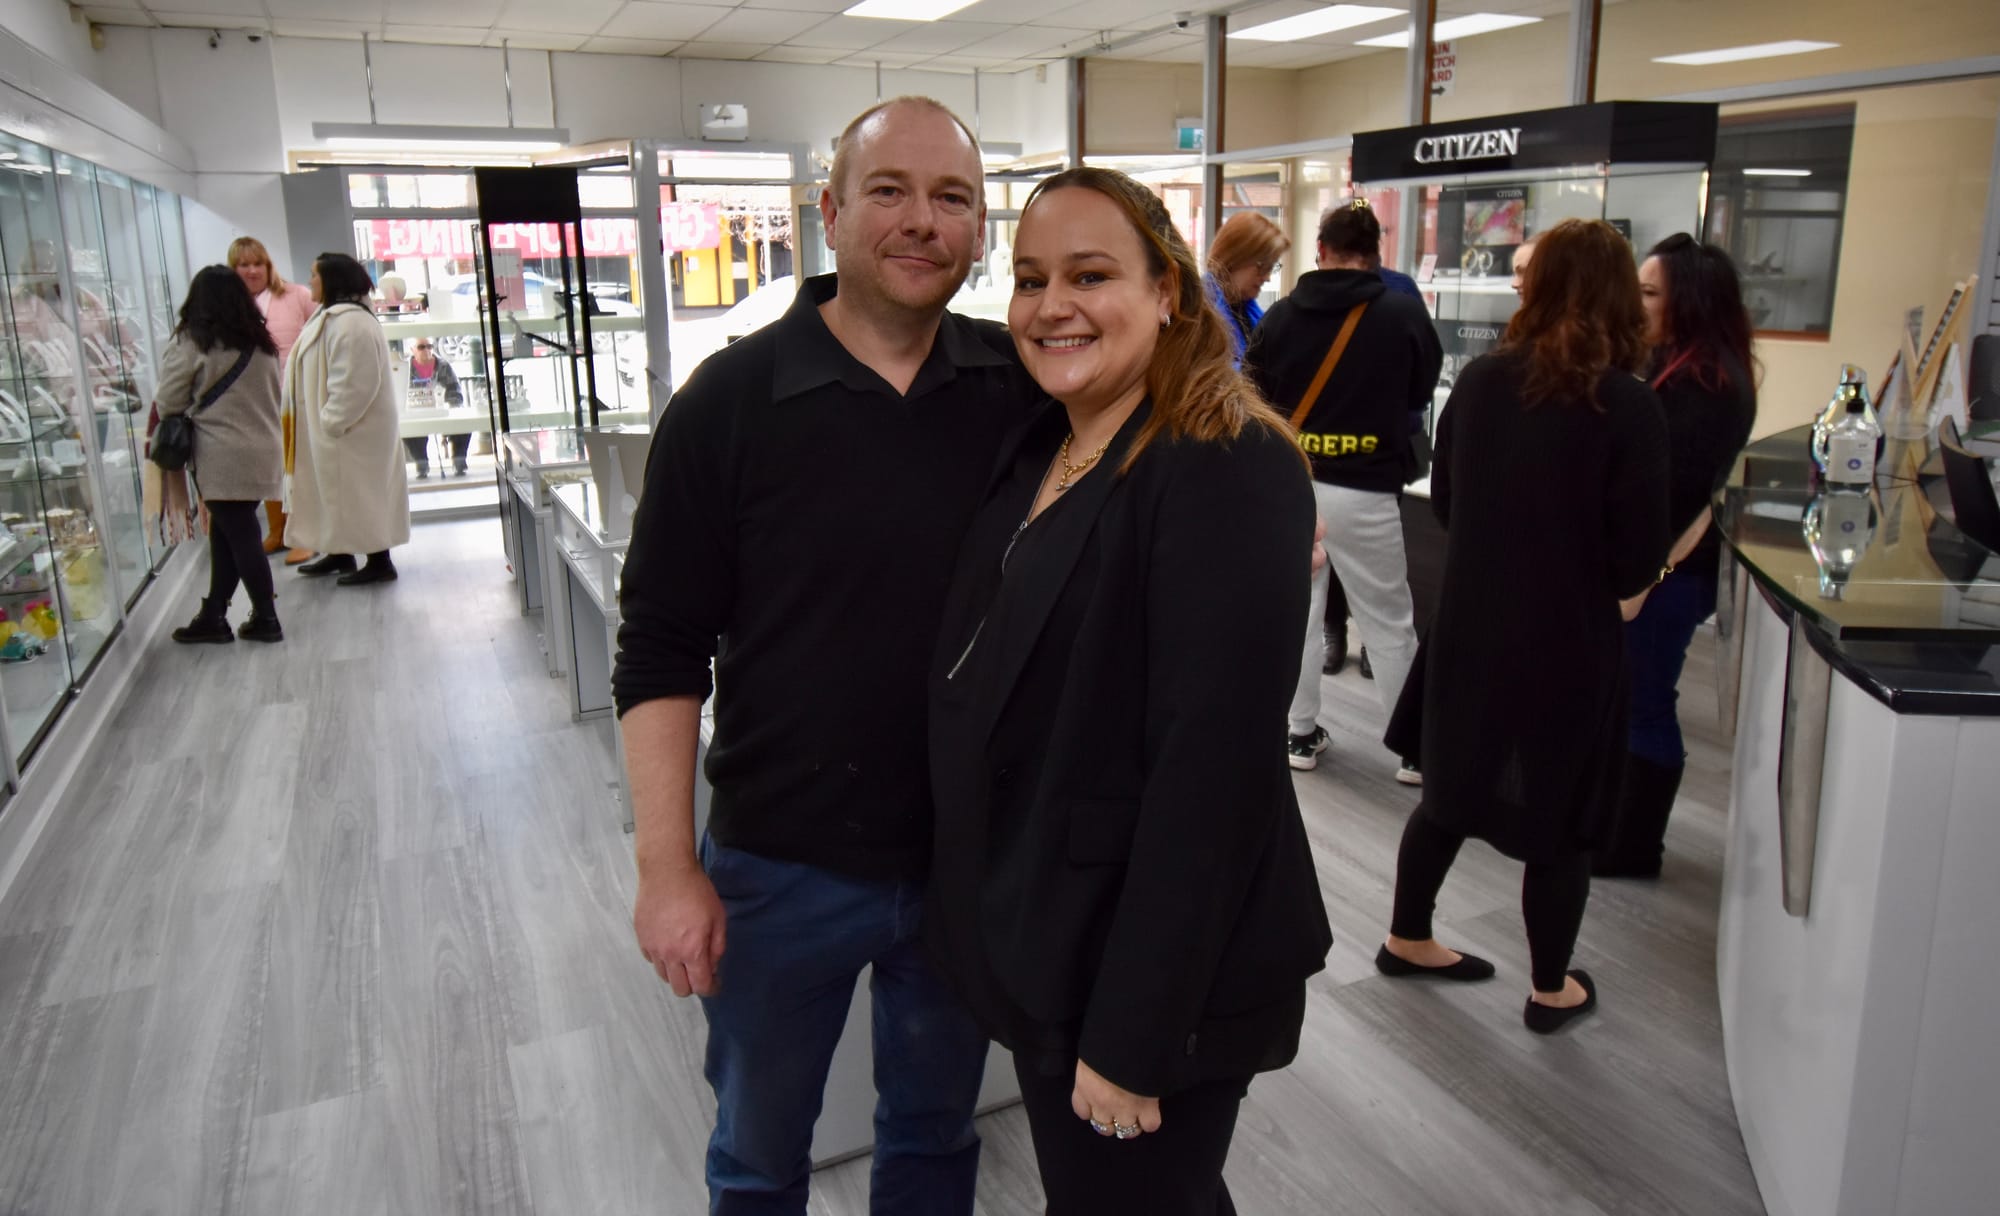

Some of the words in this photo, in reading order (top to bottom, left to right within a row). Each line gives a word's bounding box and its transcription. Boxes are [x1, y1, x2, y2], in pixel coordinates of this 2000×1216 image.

[1414, 127, 1522, 164] CITIZEN
[1458, 327, 1500, 340] CITIZEN
[1299, 432, 1379, 456] GERS
